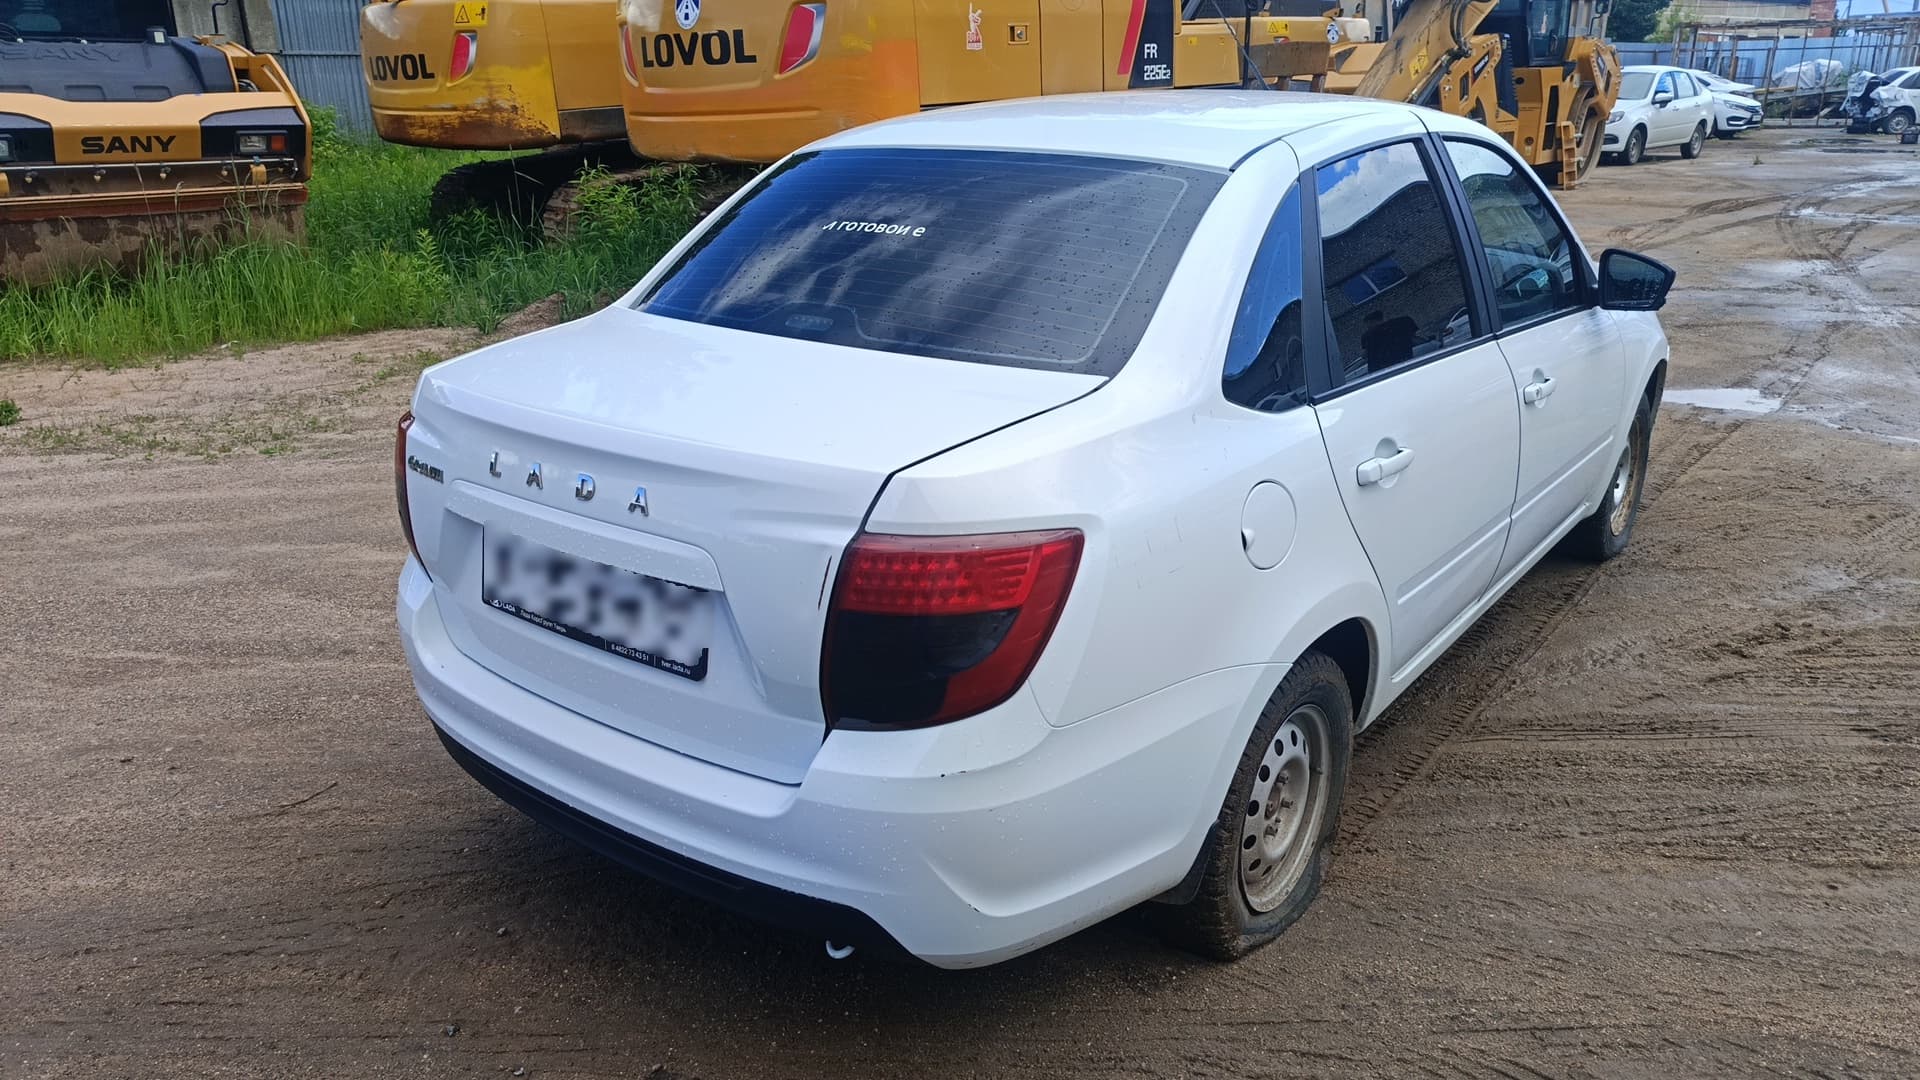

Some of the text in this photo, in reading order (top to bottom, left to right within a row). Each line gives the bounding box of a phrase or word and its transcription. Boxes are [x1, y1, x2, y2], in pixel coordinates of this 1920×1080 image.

[641, 29, 757, 68] LOVOL
[1144, 43, 1158, 59] FR
[370, 53, 435, 81] LOVOL
[81, 135, 176, 154] SANY
[489, 451, 650, 518] LADA
[503, 603, 515, 612] LADA
